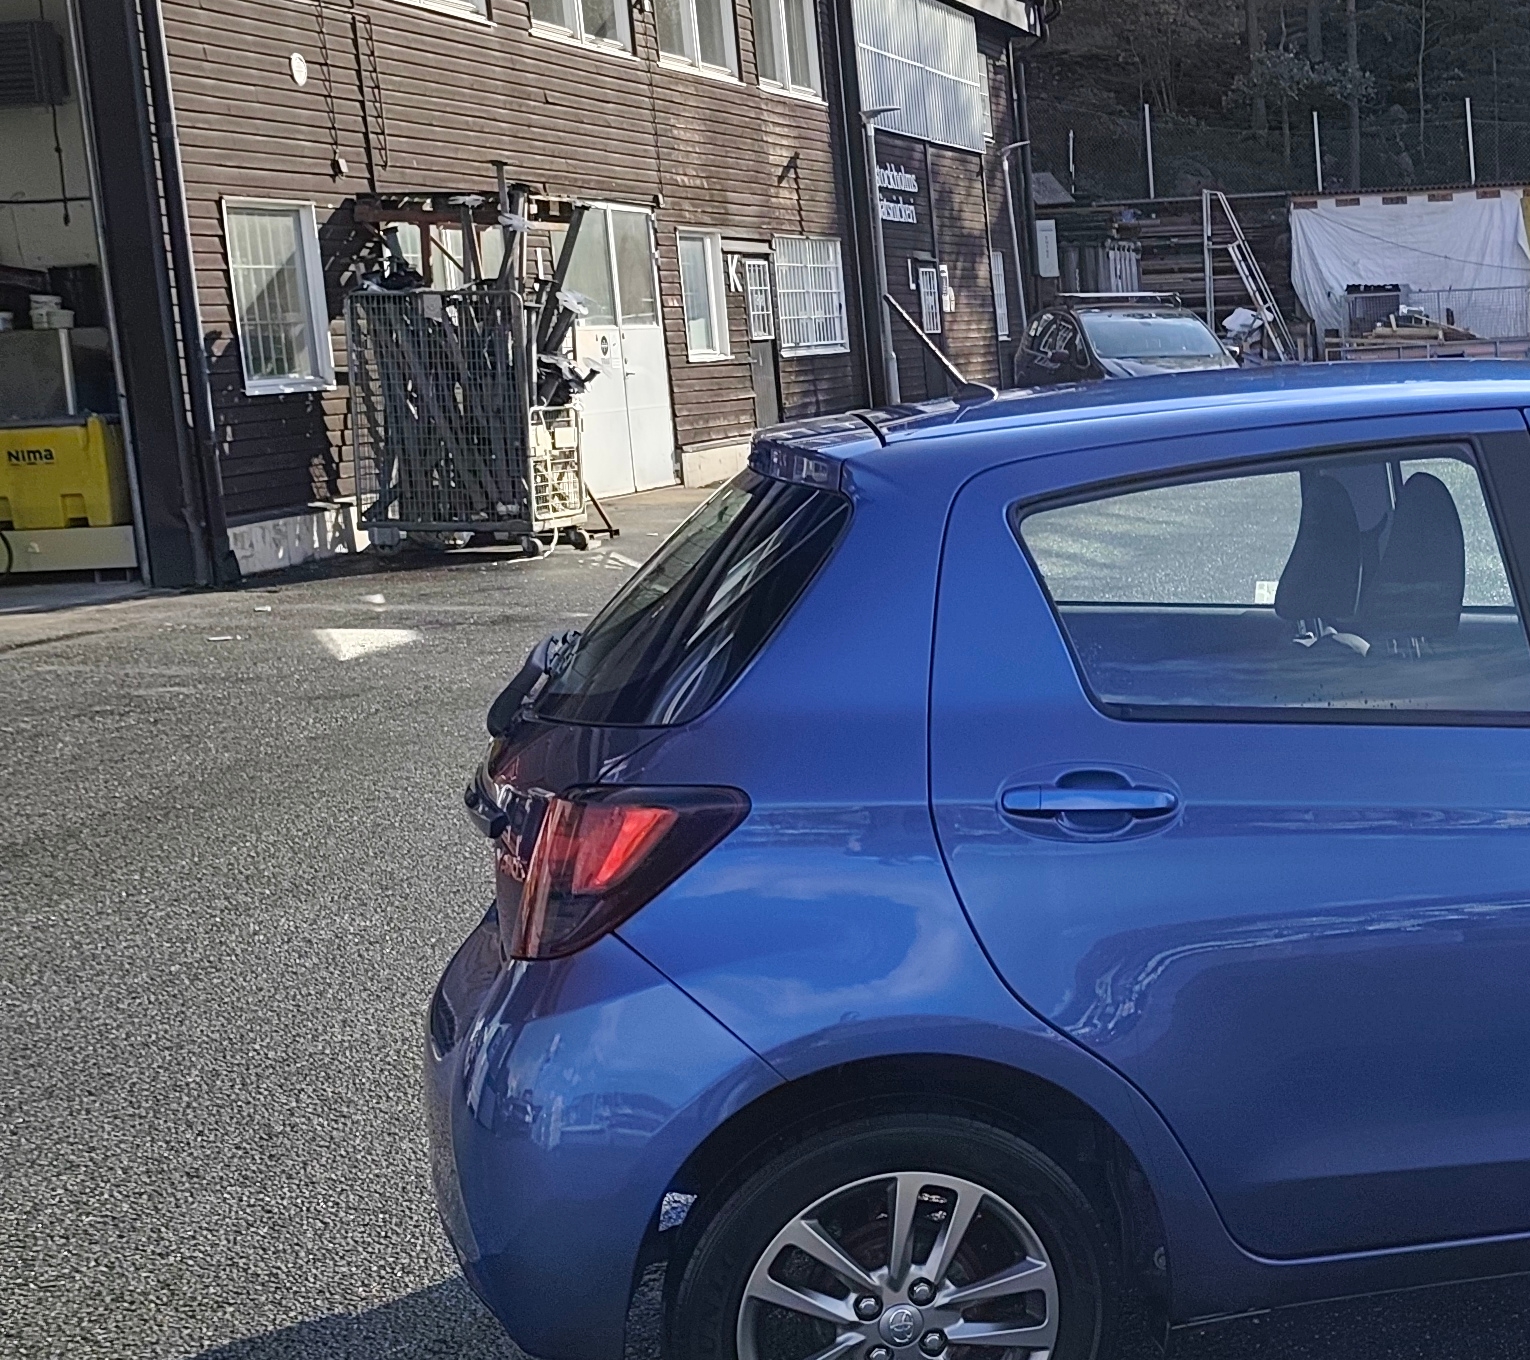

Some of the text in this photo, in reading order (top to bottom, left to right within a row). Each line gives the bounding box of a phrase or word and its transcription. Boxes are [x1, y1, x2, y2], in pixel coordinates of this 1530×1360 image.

[727, 254, 743, 292] K
[907, 258, 916, 290] L
[7, 448, 55, 463] Nima
